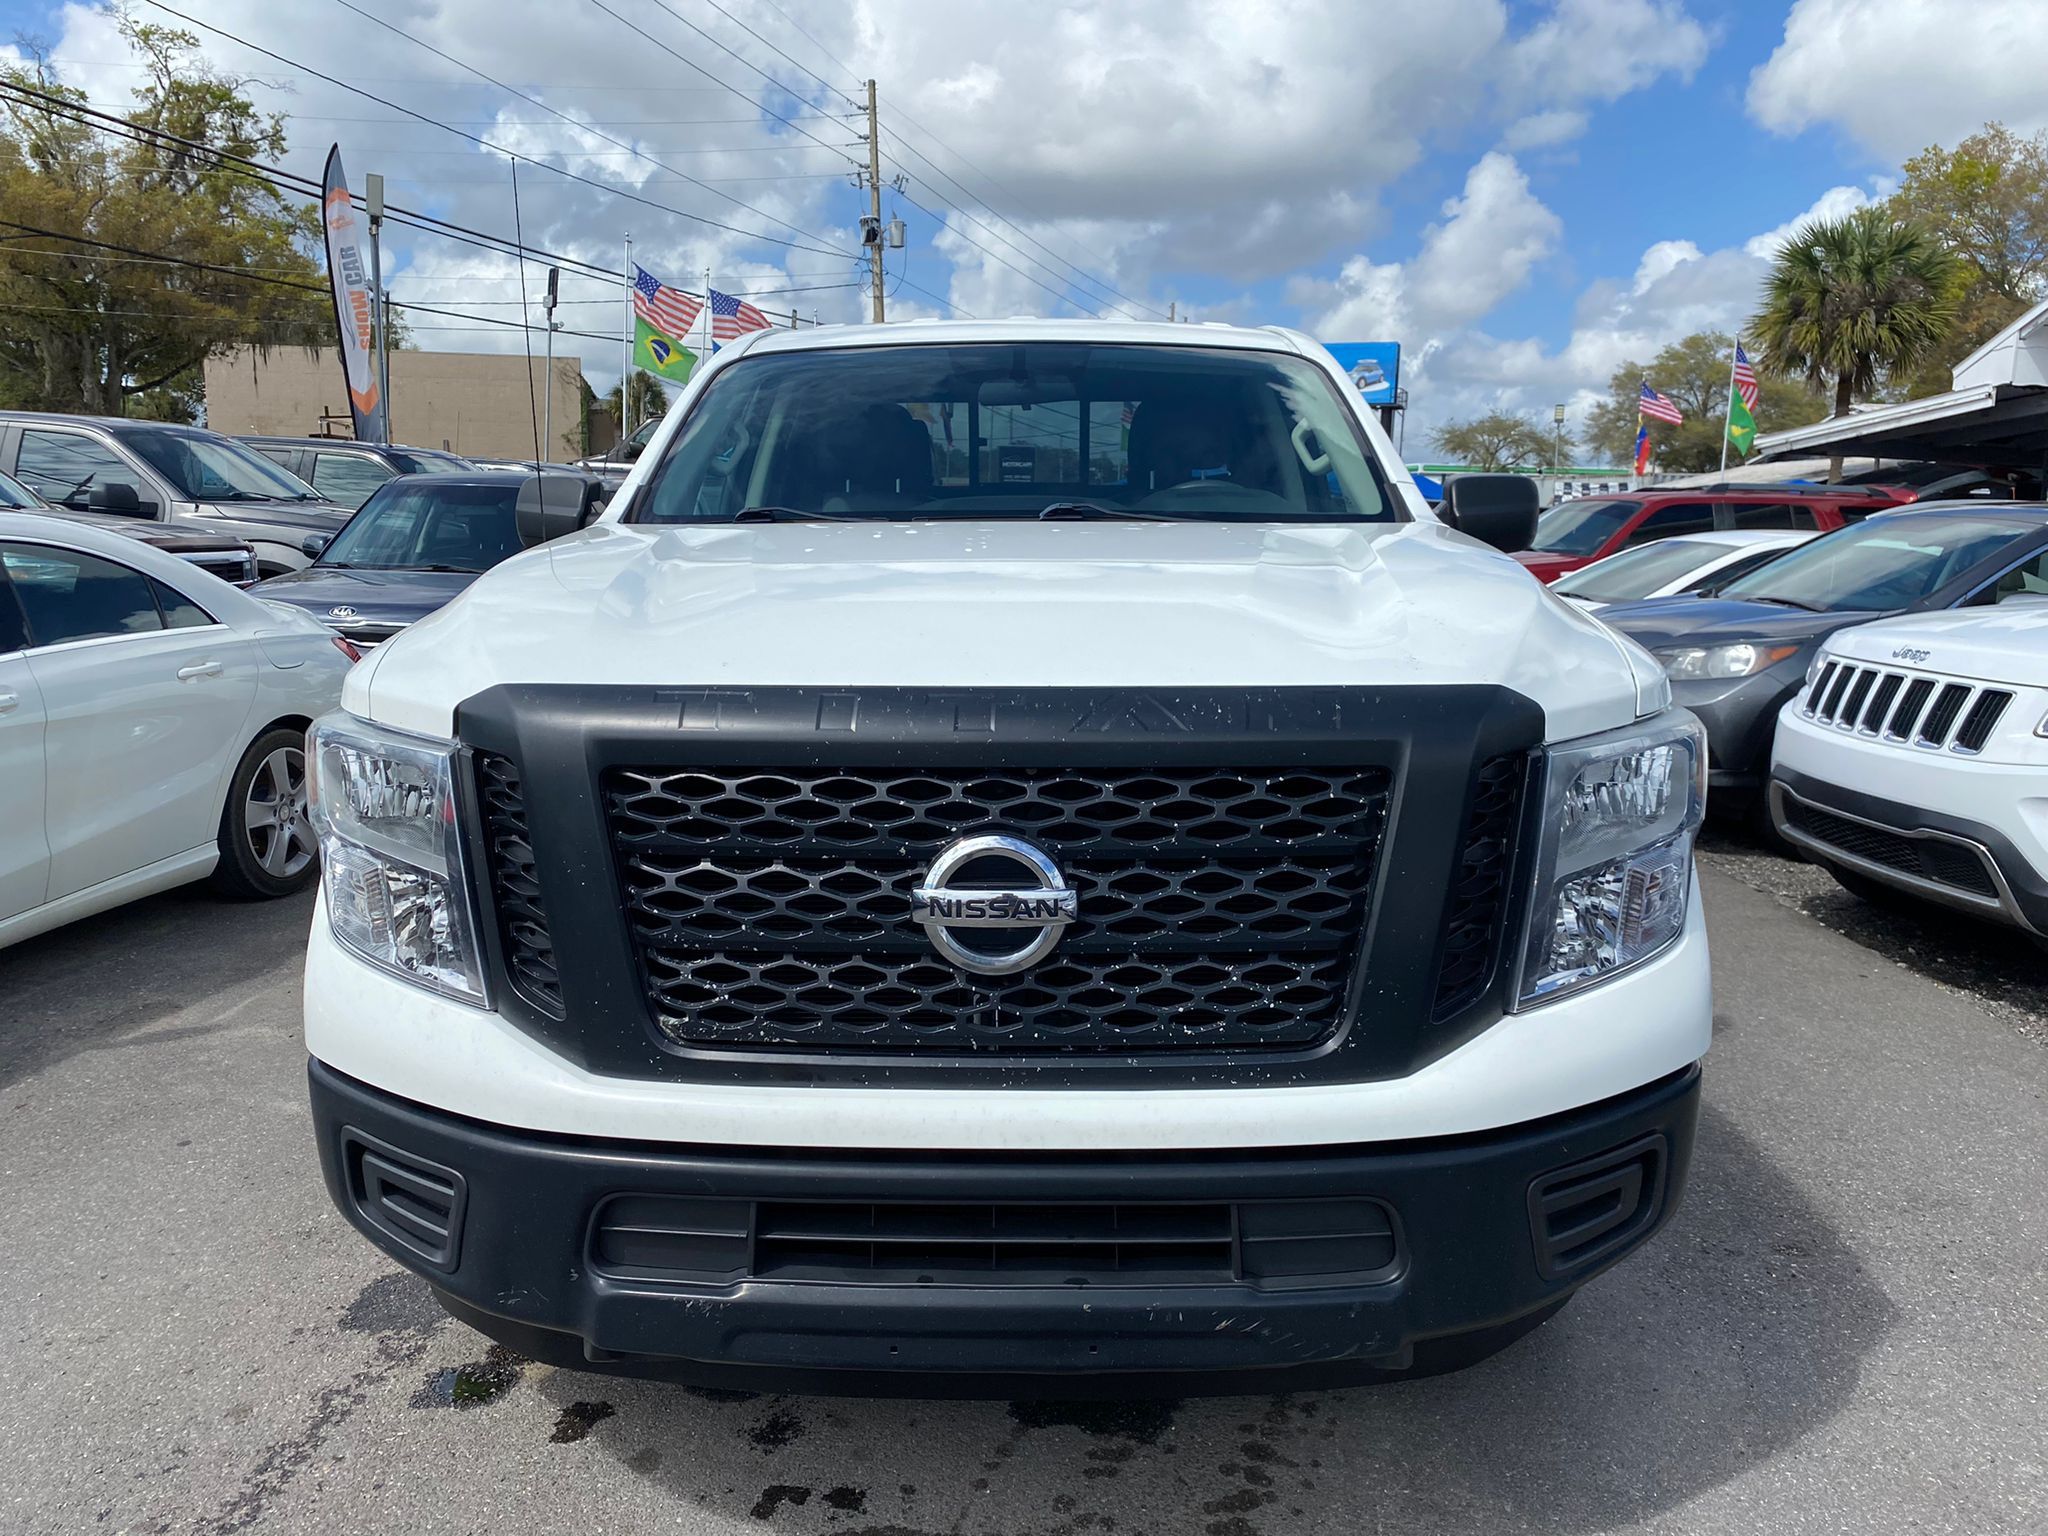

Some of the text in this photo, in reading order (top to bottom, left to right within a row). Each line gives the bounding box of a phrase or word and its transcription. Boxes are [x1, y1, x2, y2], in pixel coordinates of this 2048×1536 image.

[340, 246, 370, 350] SHOW CAR
[330, 606, 356, 617] KIA
[1892, 645, 1931, 662] Jeep
[652, 689, 1344, 732] TITAN
[929, 898, 1060, 919] NISSAN
